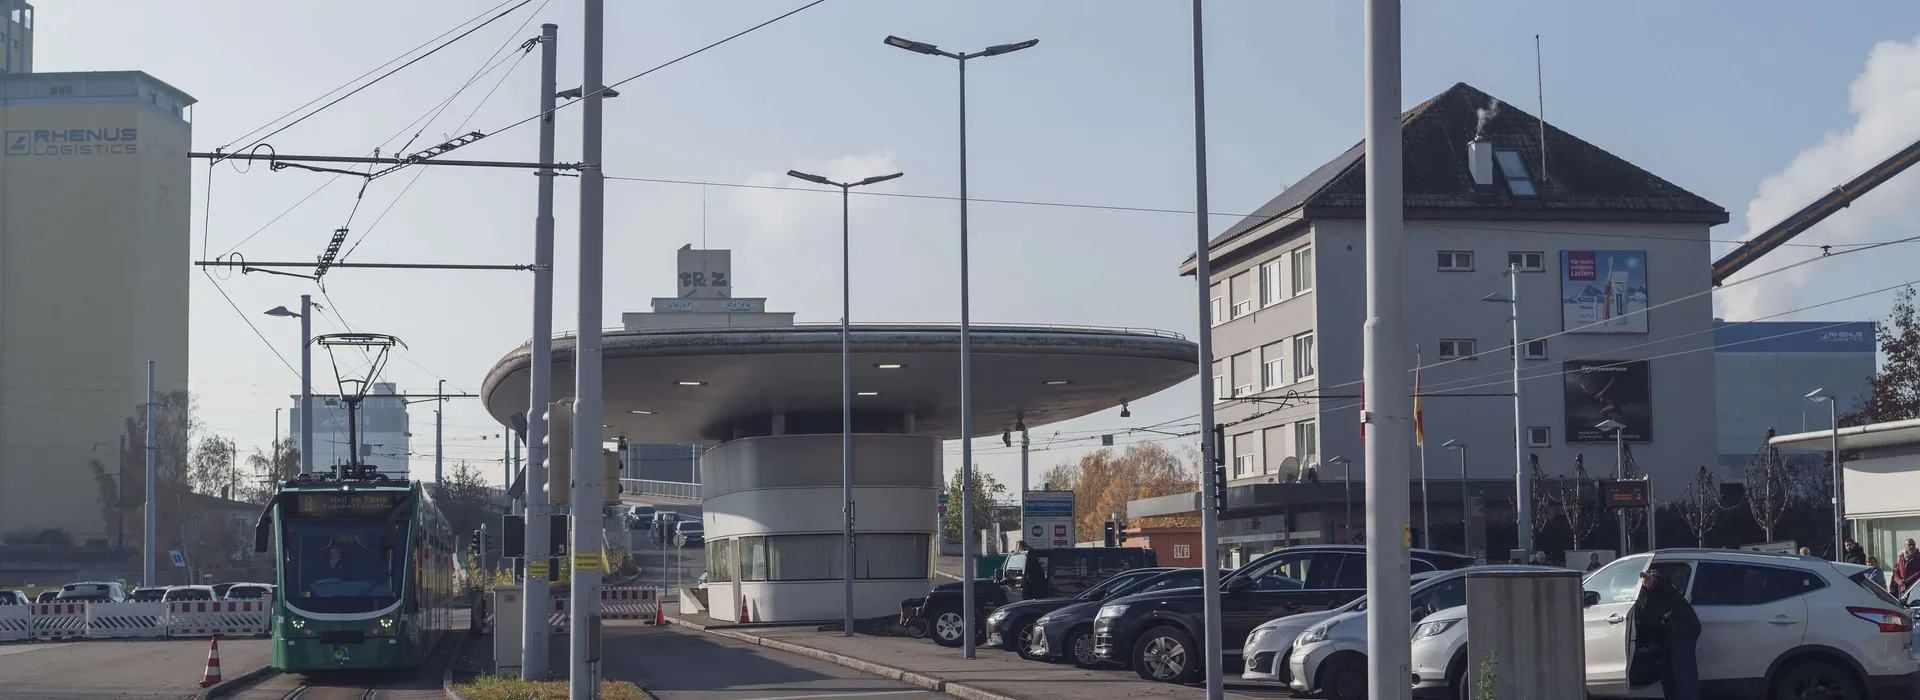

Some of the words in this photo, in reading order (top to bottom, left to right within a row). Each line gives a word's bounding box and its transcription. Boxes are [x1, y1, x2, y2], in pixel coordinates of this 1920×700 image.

[33, 128, 137, 144] RHENUS
[33, 144, 137, 156] LOGISTICS
[304, 495, 313, 511] 8
